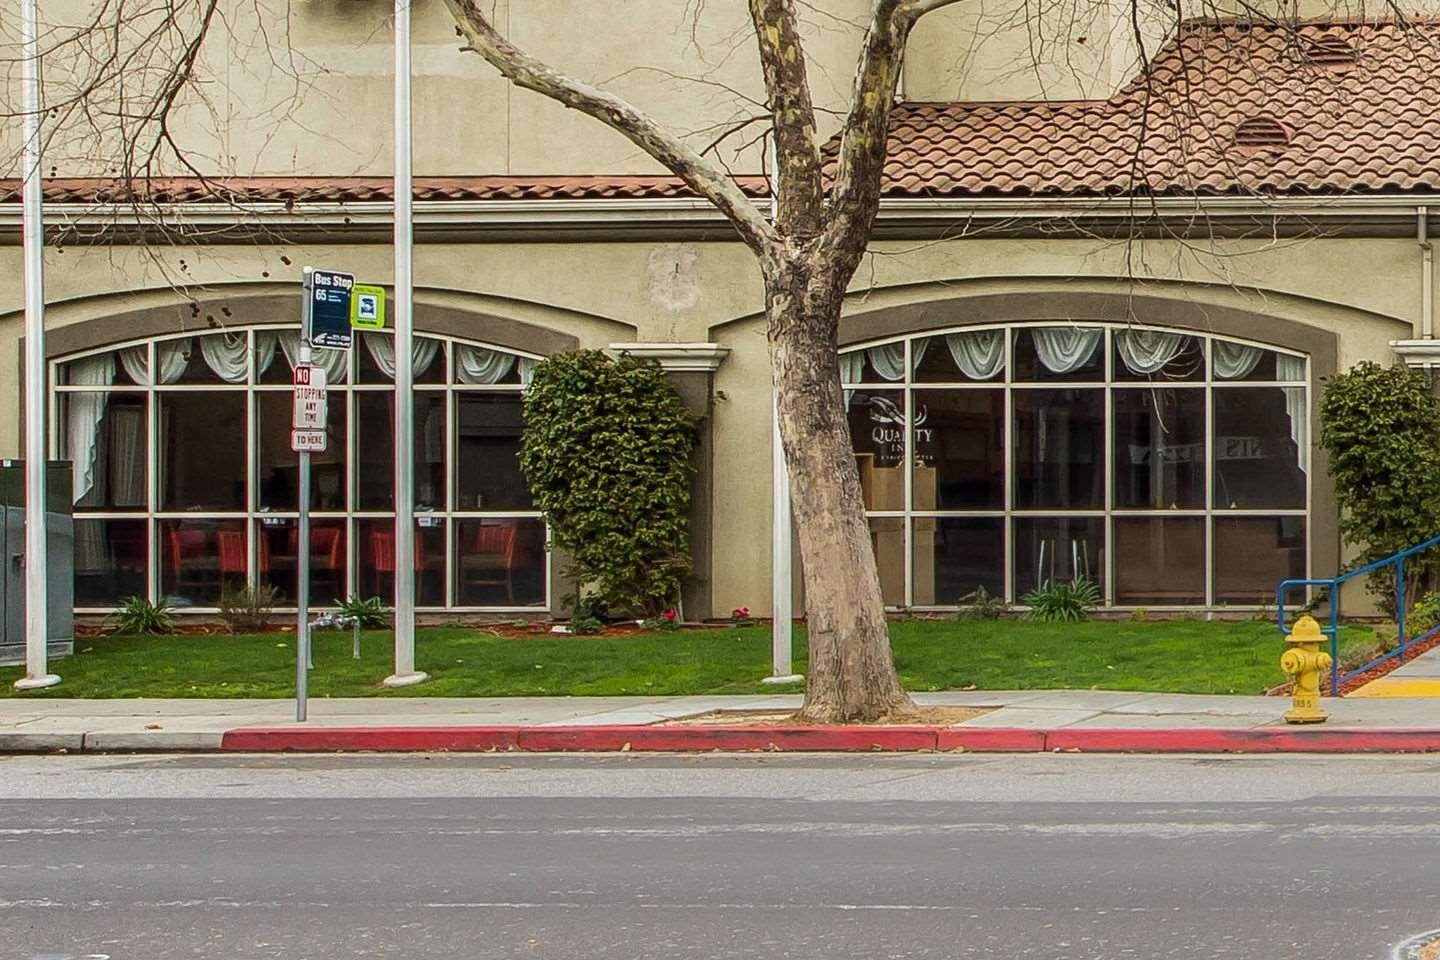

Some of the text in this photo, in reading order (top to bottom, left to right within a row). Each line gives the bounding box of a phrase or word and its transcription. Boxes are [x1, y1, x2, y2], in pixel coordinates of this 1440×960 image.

[314, 272, 353, 290] Bus Stop
[296, 368, 309, 384] NO
[296, 388, 326, 400] STOPPING
[305, 402, 317, 411] ANY
[305, 413, 317, 422] TIME
[297, 435, 323, 445] TO HERE
[872, 426, 932, 444] QUATY
